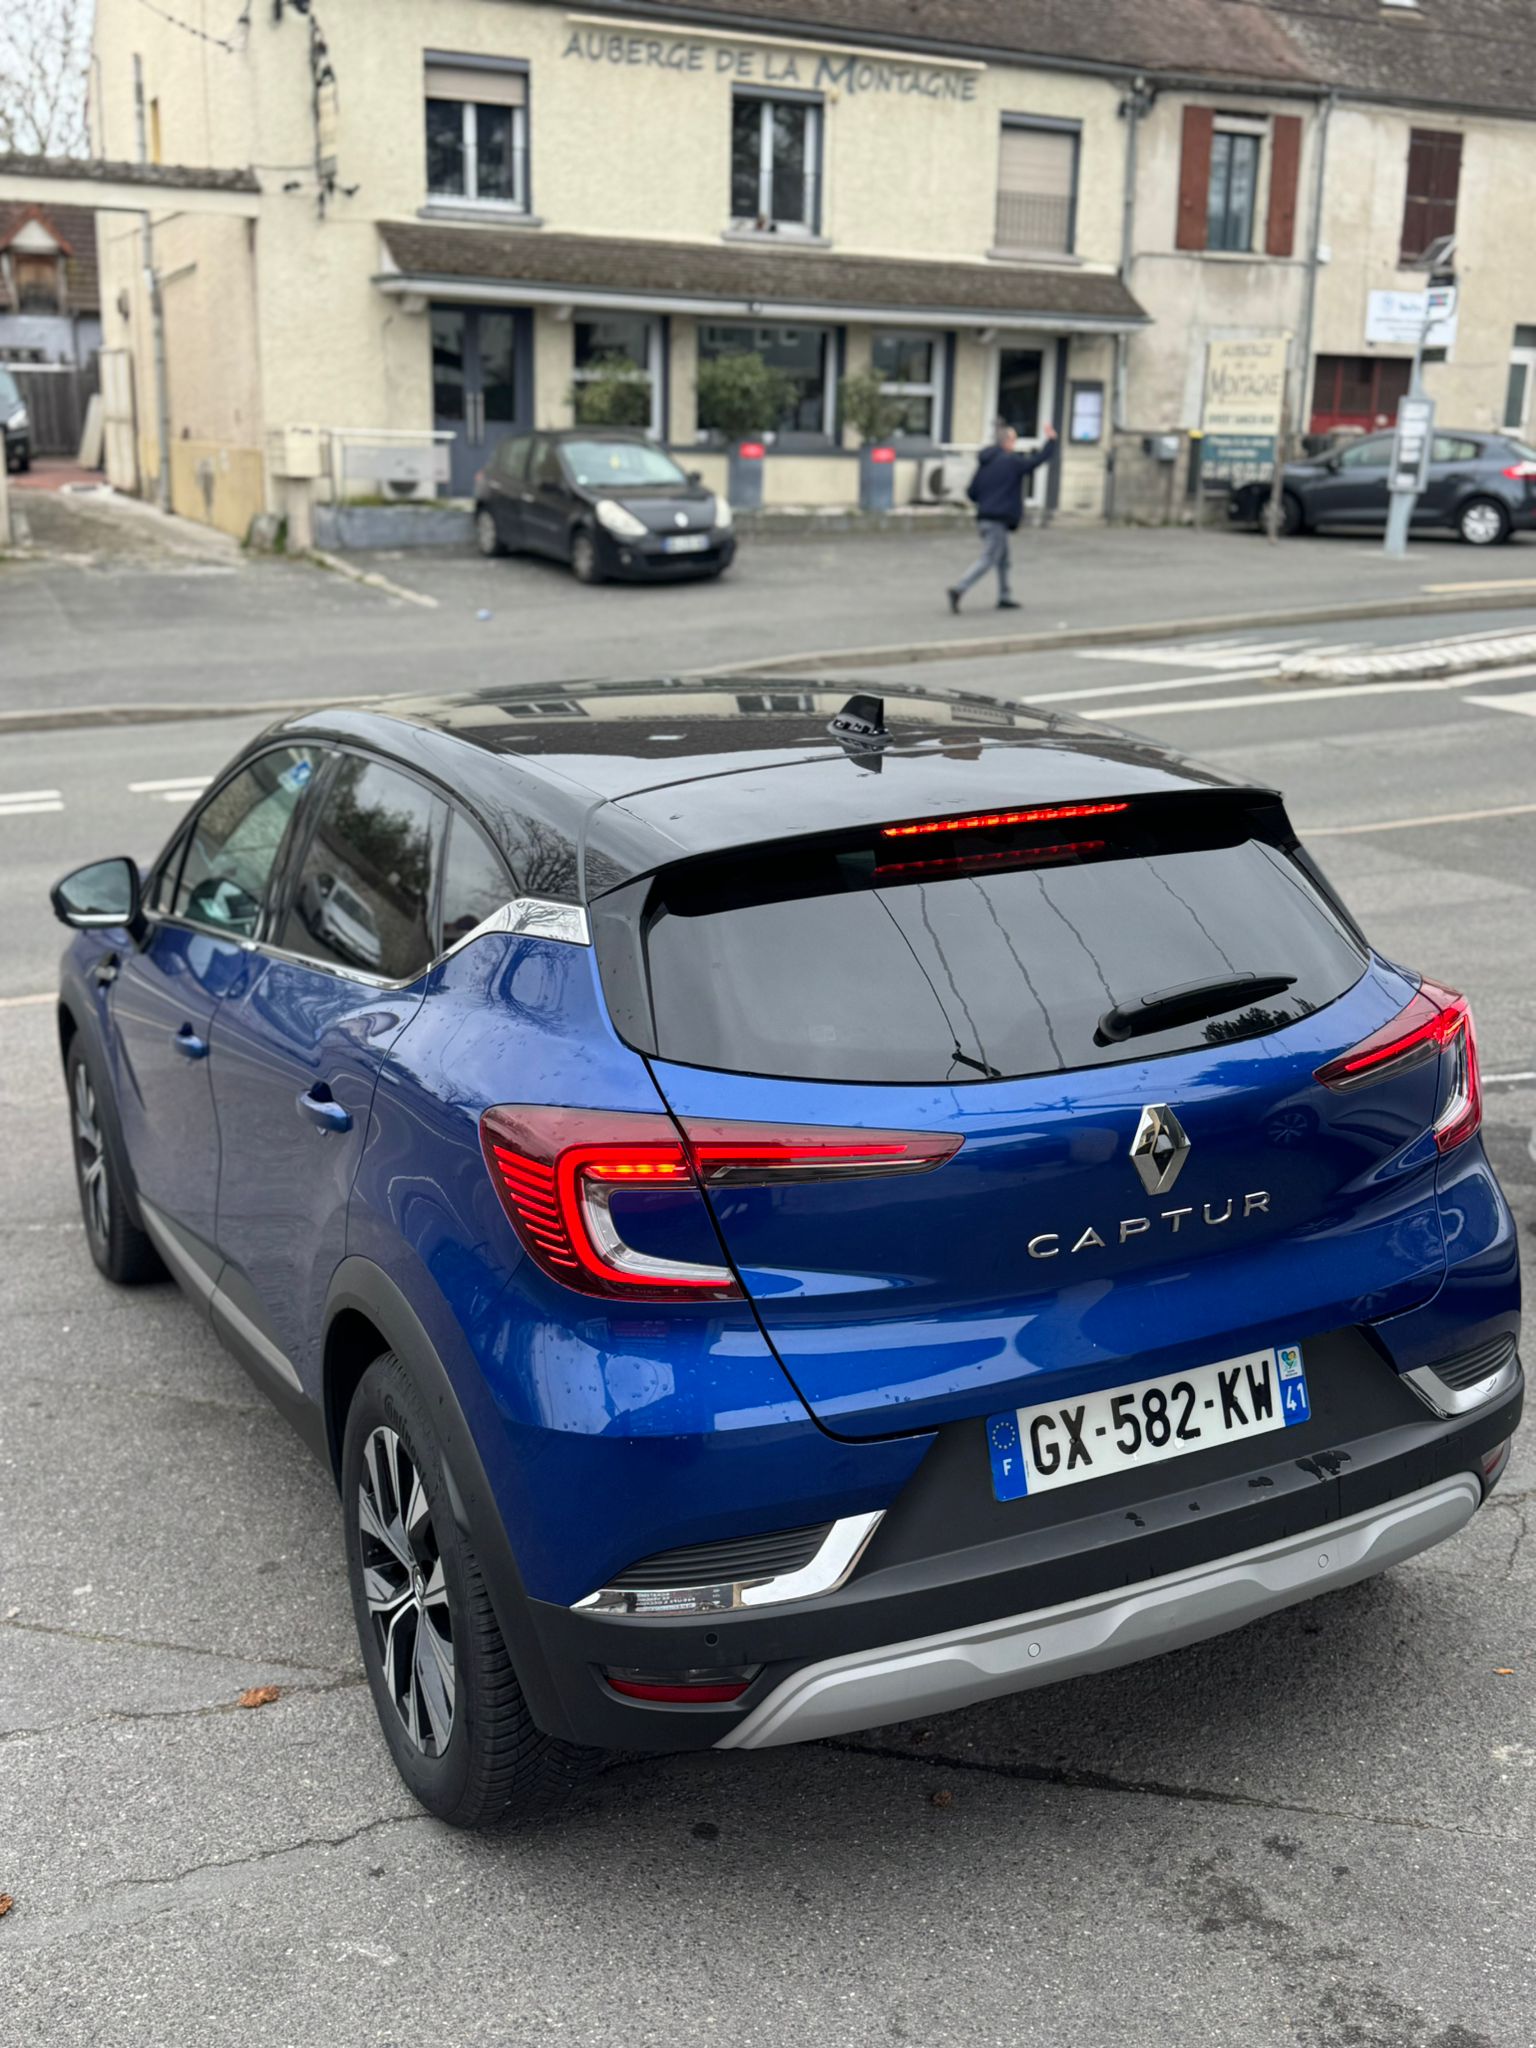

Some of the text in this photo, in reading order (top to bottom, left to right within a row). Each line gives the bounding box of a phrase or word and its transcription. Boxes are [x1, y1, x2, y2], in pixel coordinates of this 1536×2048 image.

[562, 31, 978, 102] AUBERGE DE LA MONTAGNE
[1027, 1190, 1272, 1259] CAPTUR
[1029, 1359, 1275, 1477] GX-582-KW
[1285, 1381, 1308, 1412] 41
[1002, 1457, 1013, 1477] F
